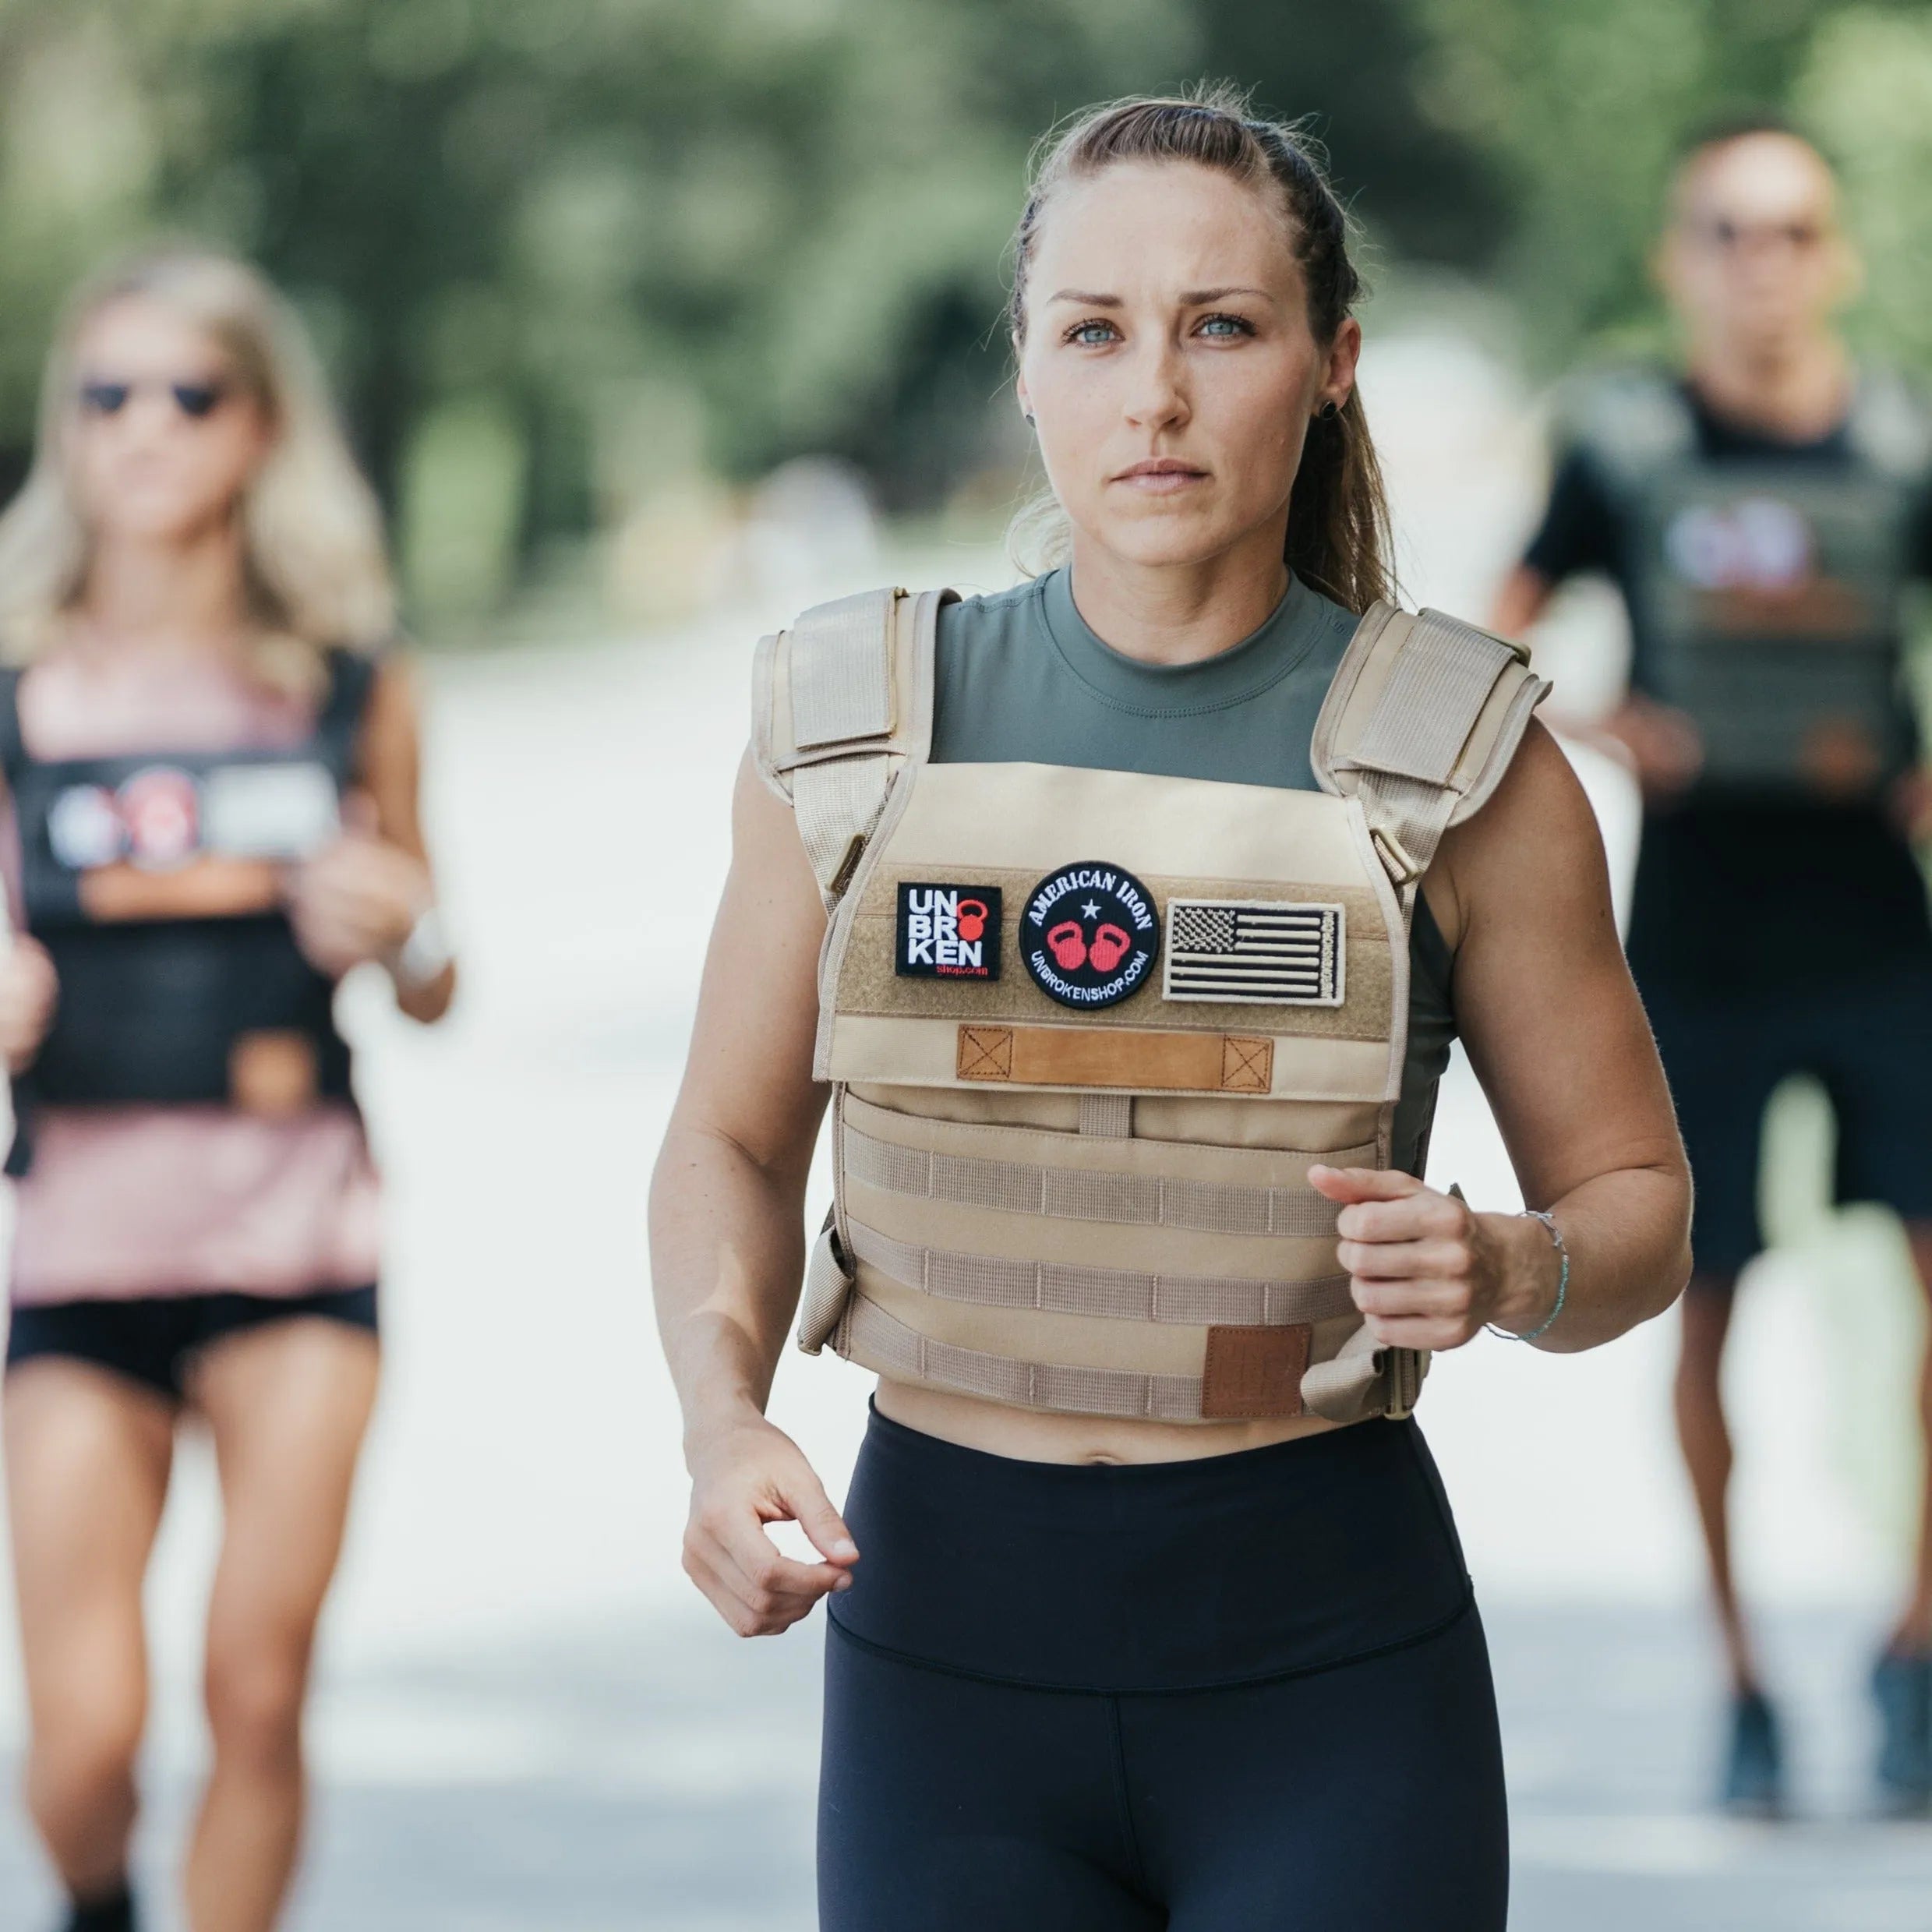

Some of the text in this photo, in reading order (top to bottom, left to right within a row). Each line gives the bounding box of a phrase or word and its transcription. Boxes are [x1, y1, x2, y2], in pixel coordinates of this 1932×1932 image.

[909, 888, 958, 917] UN
[1029, 870, 1153, 930] AMERICAN IRON
[908, 938, 982, 966] KEN
[936, 966, 988, 976] shop.com
[1031, 950, 1149, 1001] UNBROKENSHOP.COM
